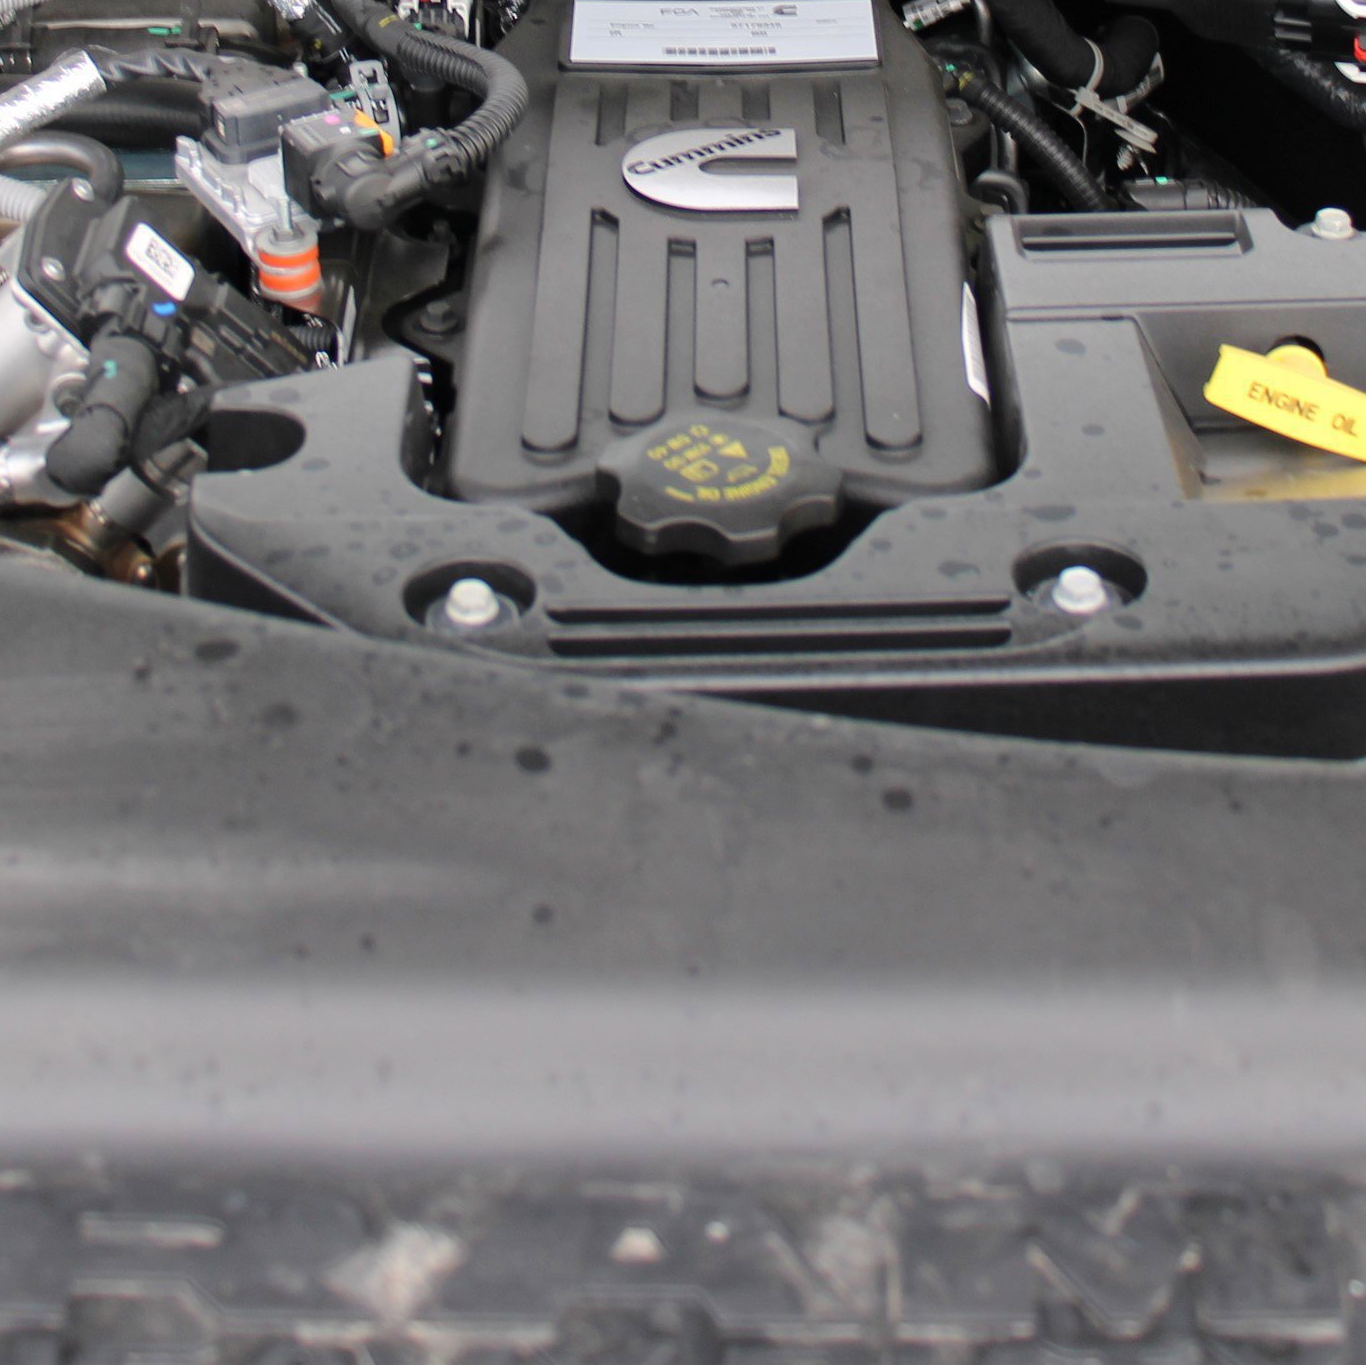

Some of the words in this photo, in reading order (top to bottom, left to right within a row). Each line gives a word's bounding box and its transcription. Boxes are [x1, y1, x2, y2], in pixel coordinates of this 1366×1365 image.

[627, 128, 782, 176] Cummins
[1247, 381, 1320, 422] ENGINE
[1331, 412, 1359, 438] OIL
